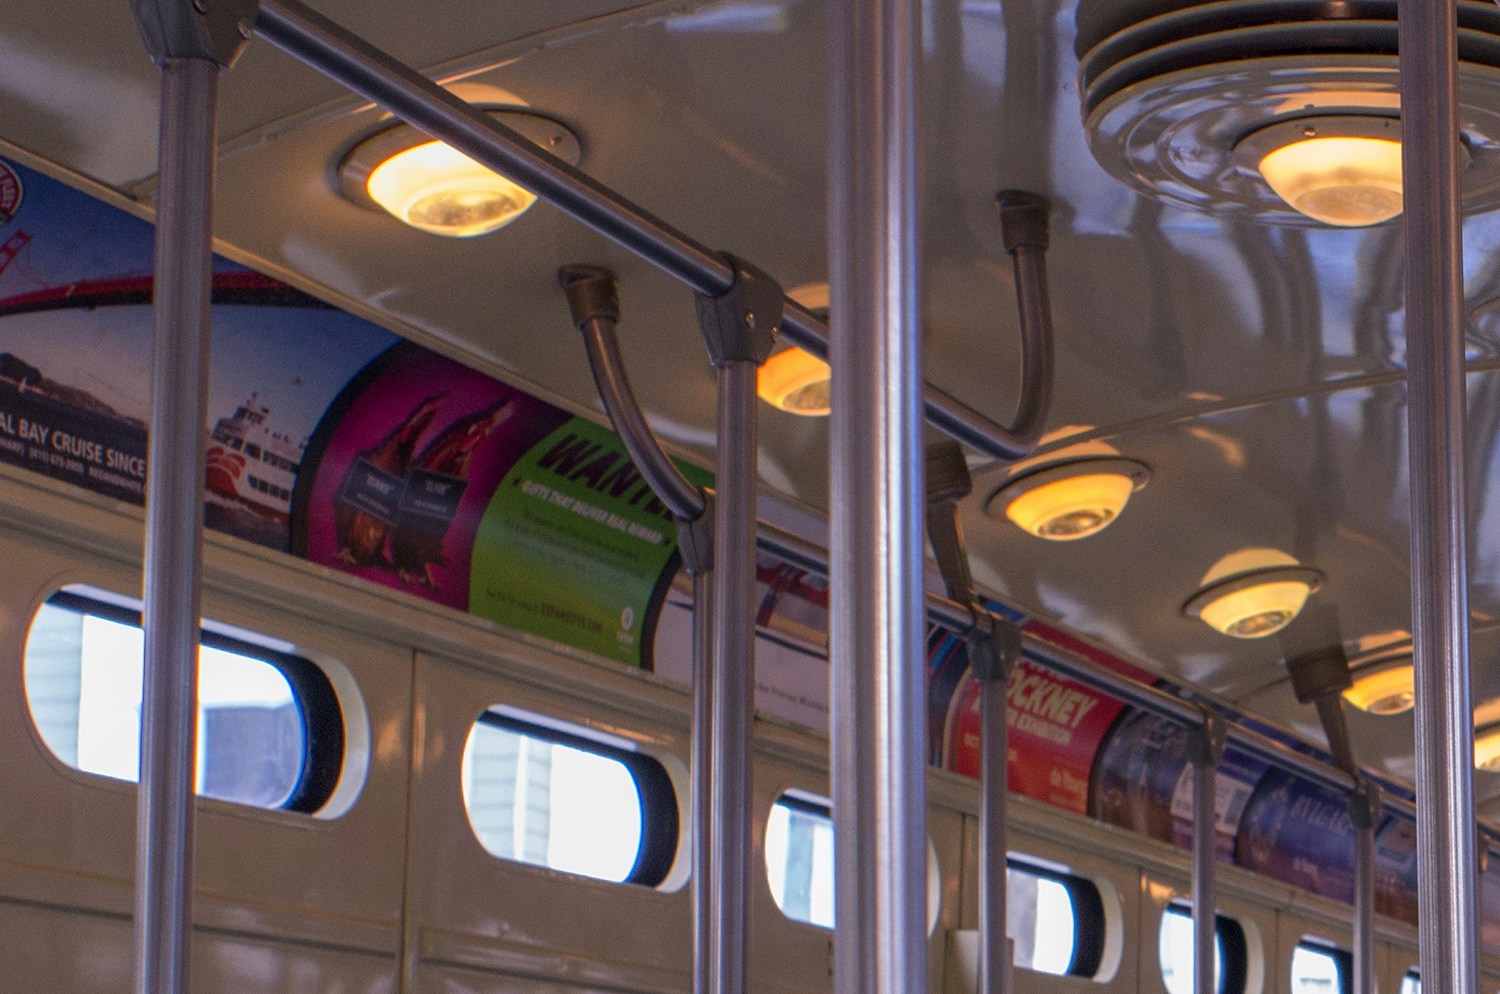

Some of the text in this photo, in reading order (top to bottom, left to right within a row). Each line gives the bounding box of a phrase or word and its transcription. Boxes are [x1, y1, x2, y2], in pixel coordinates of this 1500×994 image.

[18, 418, 49, 445] BAY
[51, 429, 103, 463] CRUISE
[105, 447, 146, 477] SINCE
[537, 433, 674, 522] WAN
[971, 666, 1098, 729] OCKNEY
